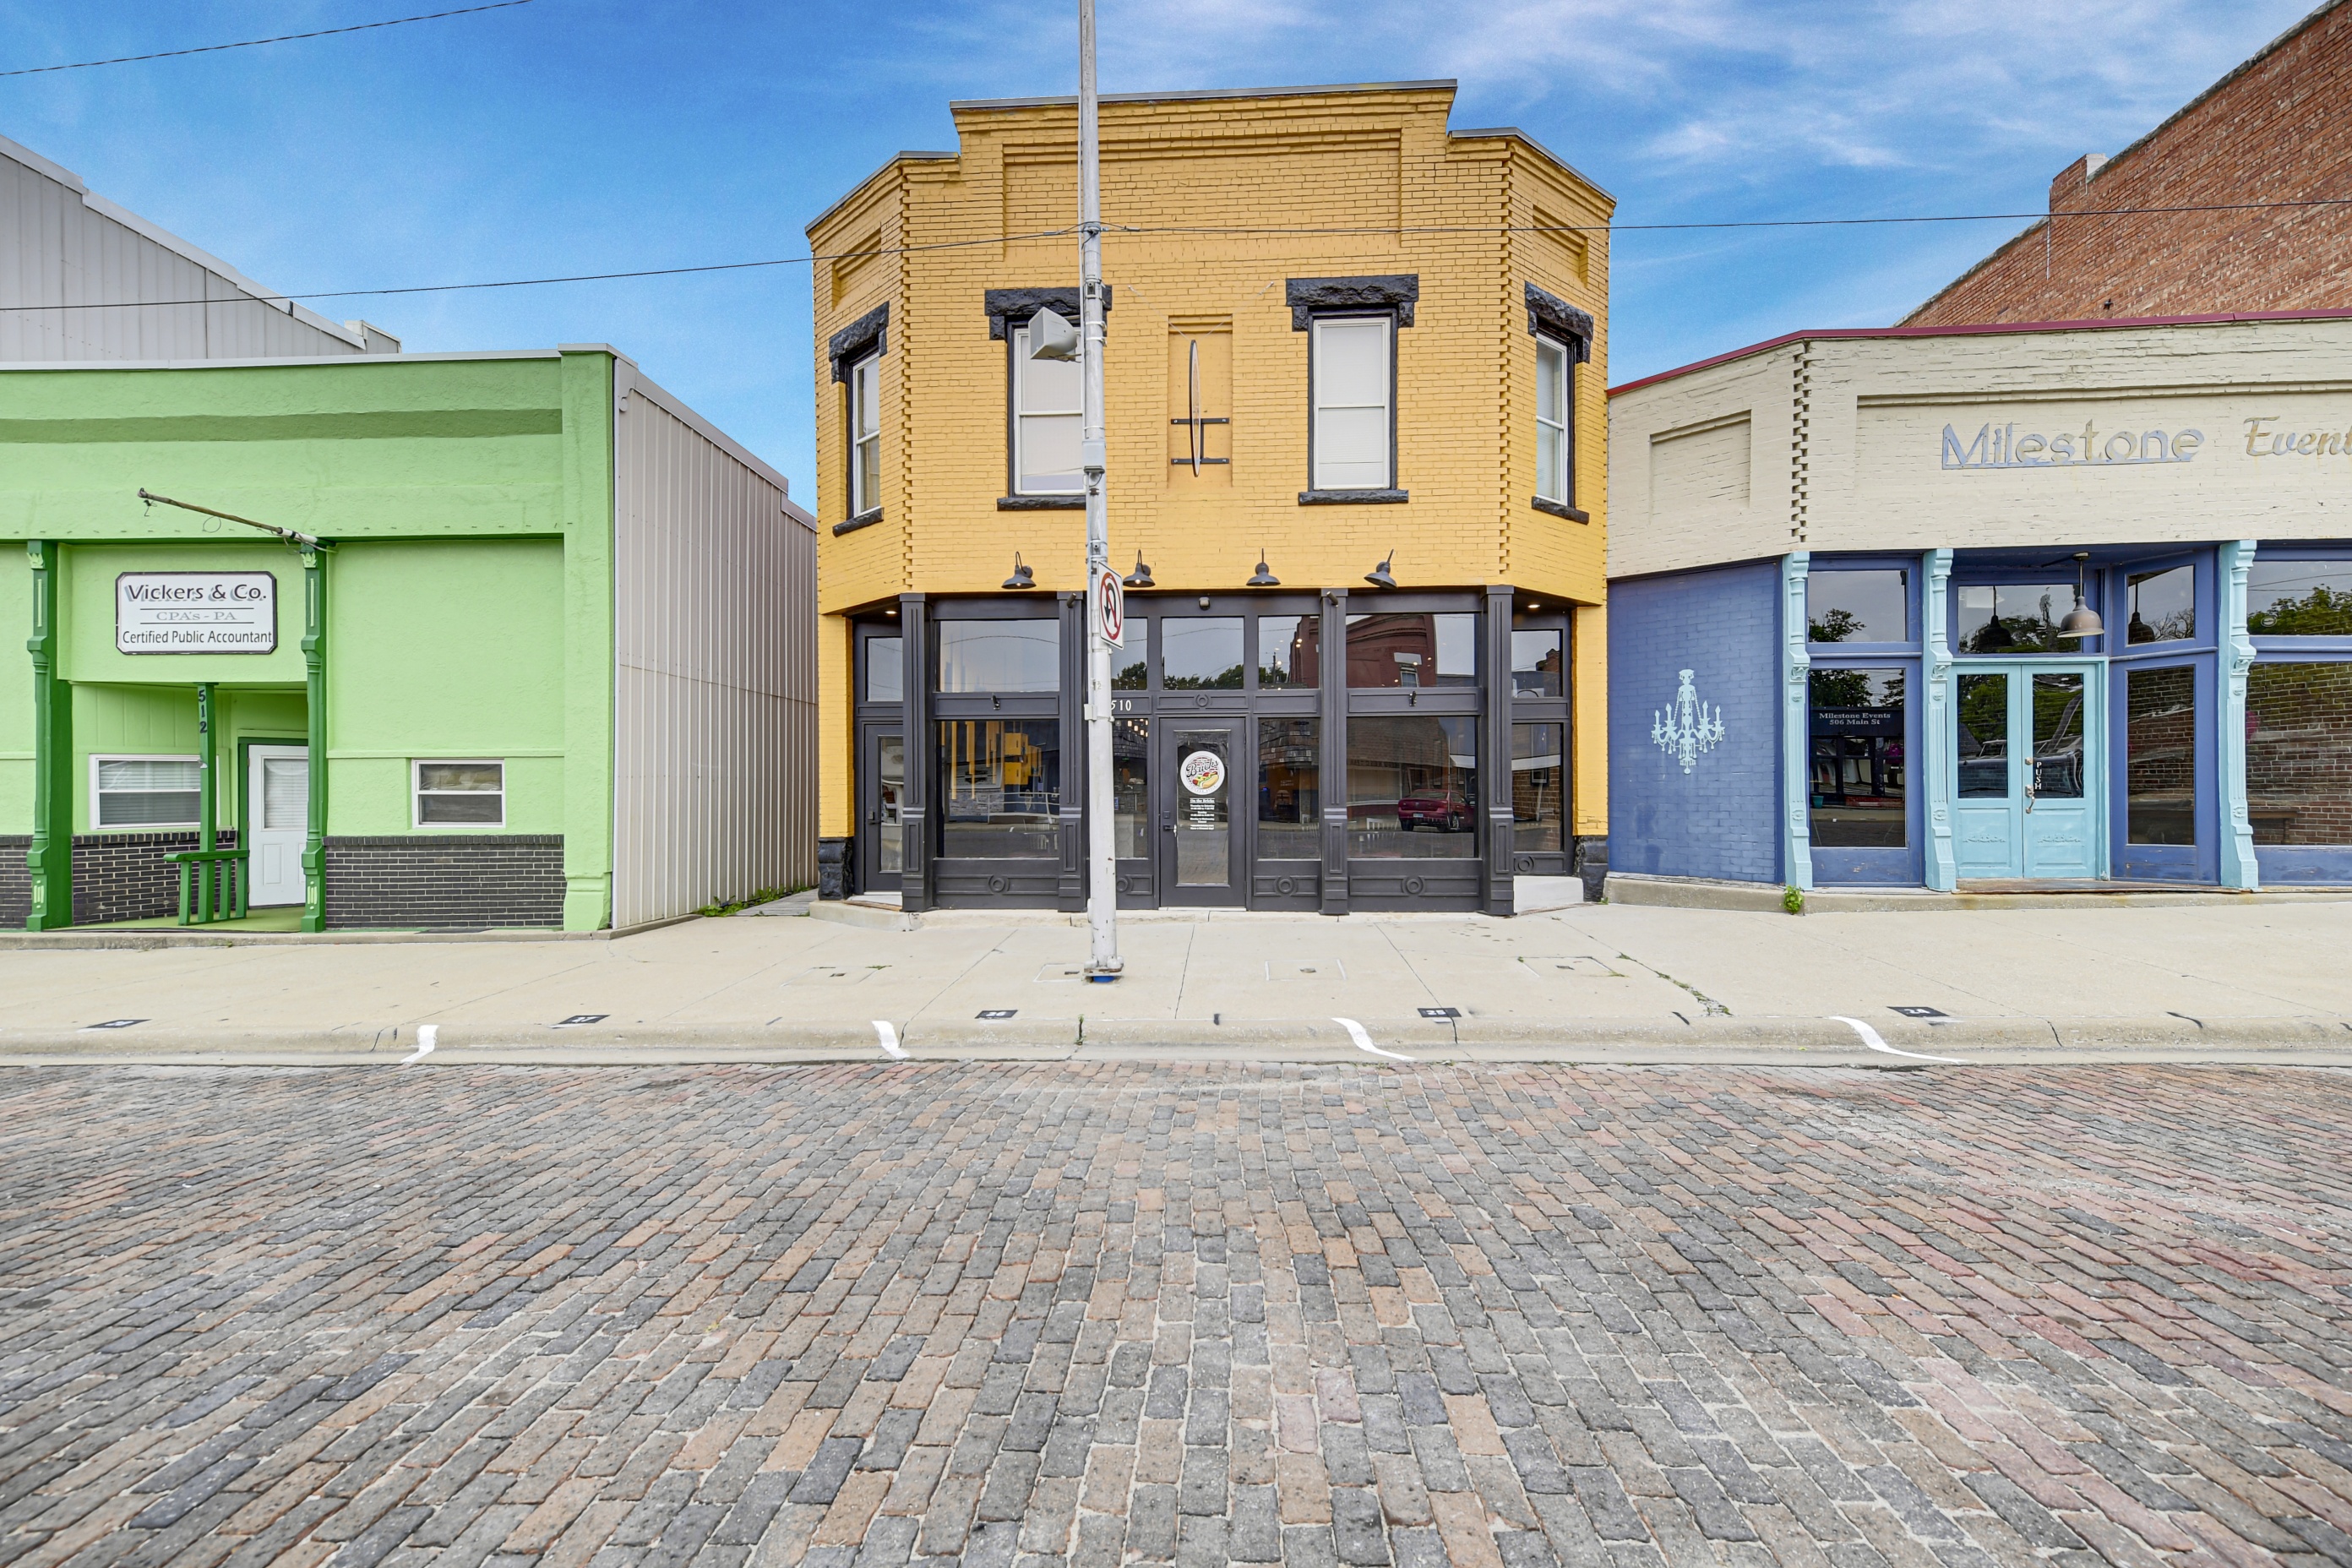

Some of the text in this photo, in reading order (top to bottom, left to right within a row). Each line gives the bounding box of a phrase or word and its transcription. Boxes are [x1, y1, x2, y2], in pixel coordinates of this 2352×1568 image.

[1942, 419, 2205, 470] Milestone
[127, 584, 267, 600] Vickers & Co.
[156, 611, 200, 621] CPA's
[214, 611, 237, 620] PA
[122, 630, 272, 644] Certified Public Accountant
[199, 689, 208, 733] 512
[1111, 700, 1131, 711] 510
